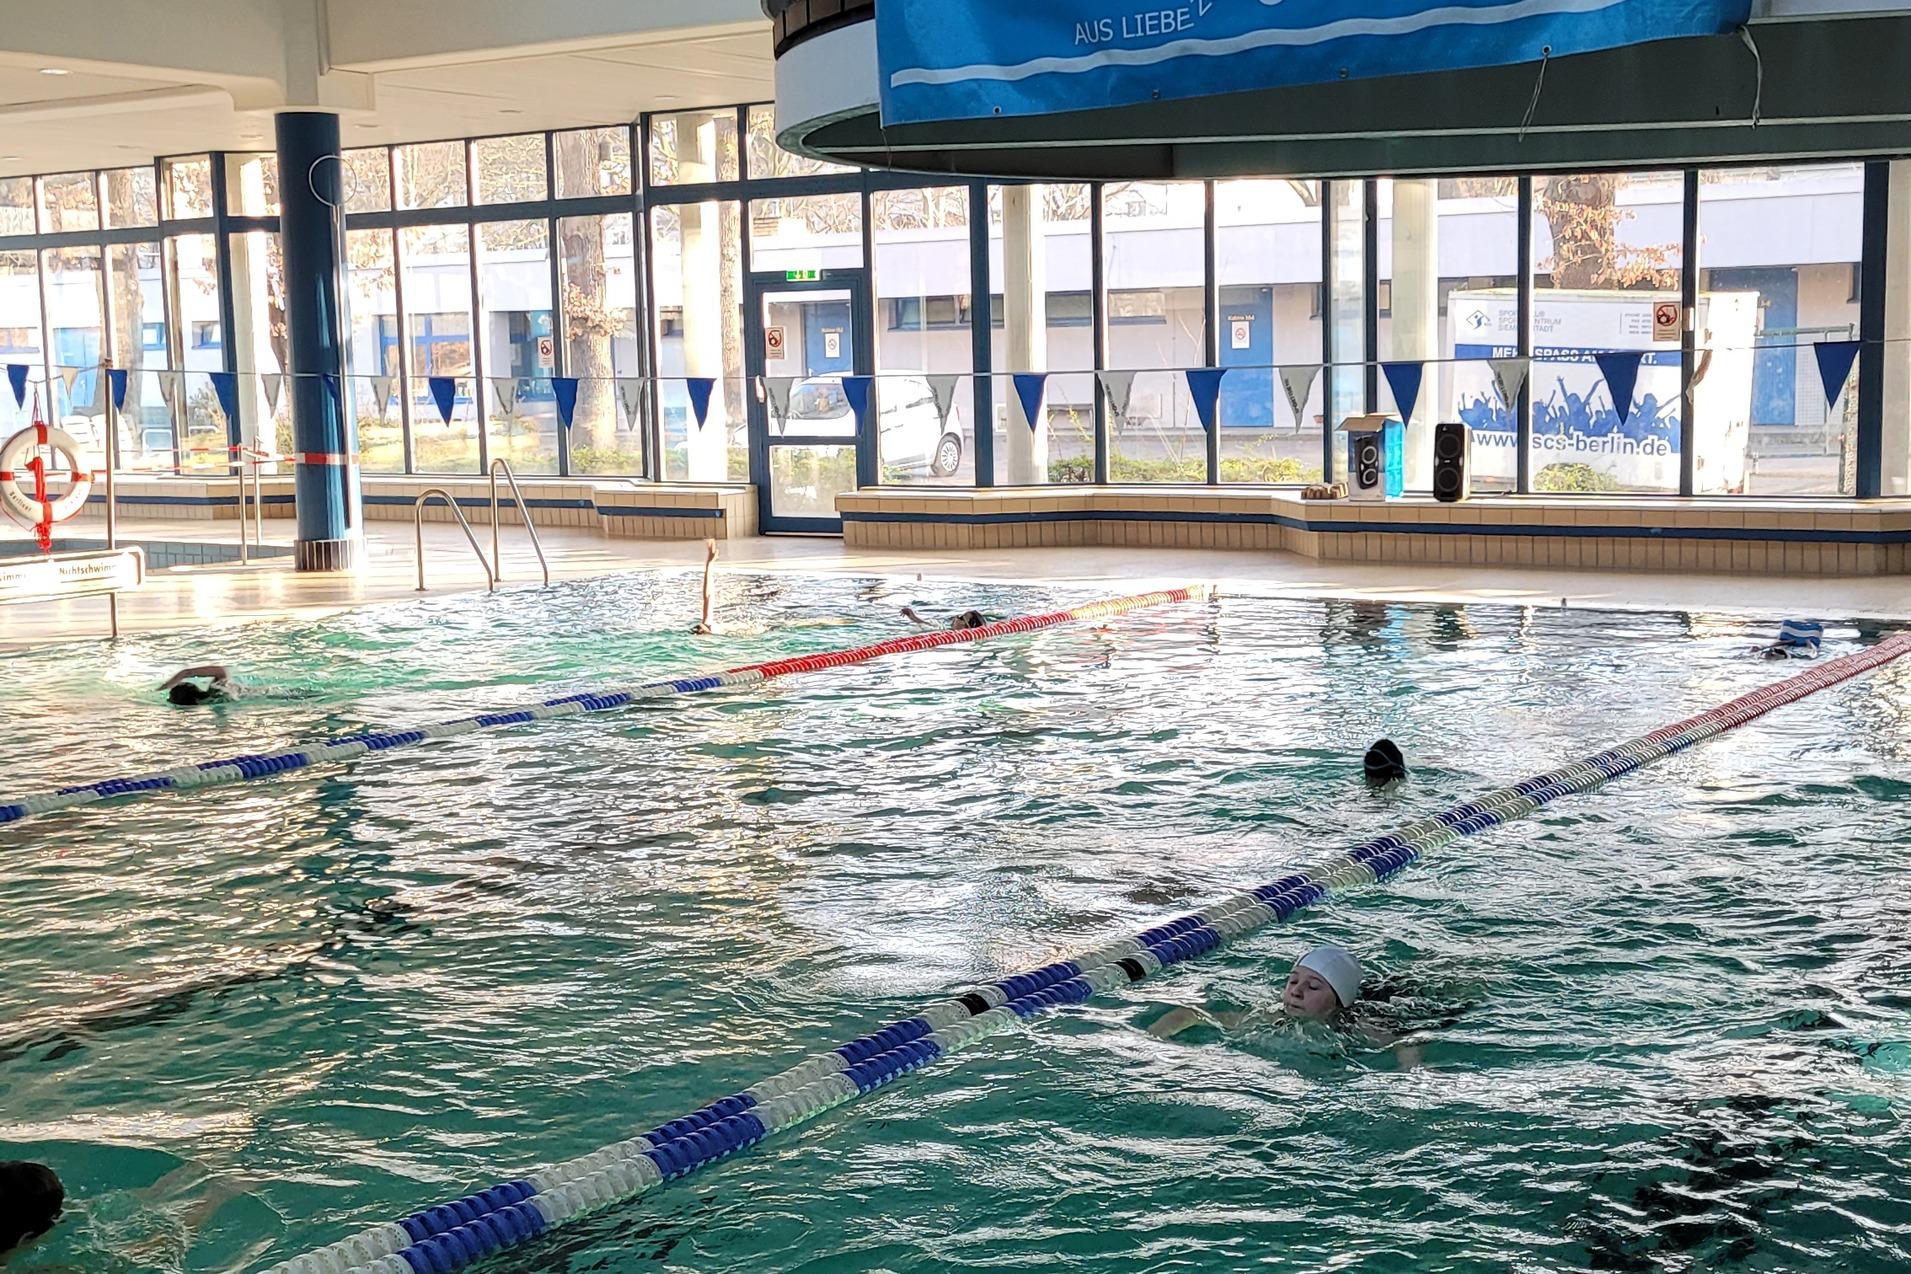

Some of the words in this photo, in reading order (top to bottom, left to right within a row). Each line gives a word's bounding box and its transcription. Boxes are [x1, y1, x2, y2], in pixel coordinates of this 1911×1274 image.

[1074, 18, 1113, 45] AUS
[1121, 7, 1194, 39] LIEBE
[1476, 432, 1667, 456] wwwscs-berlin.de
